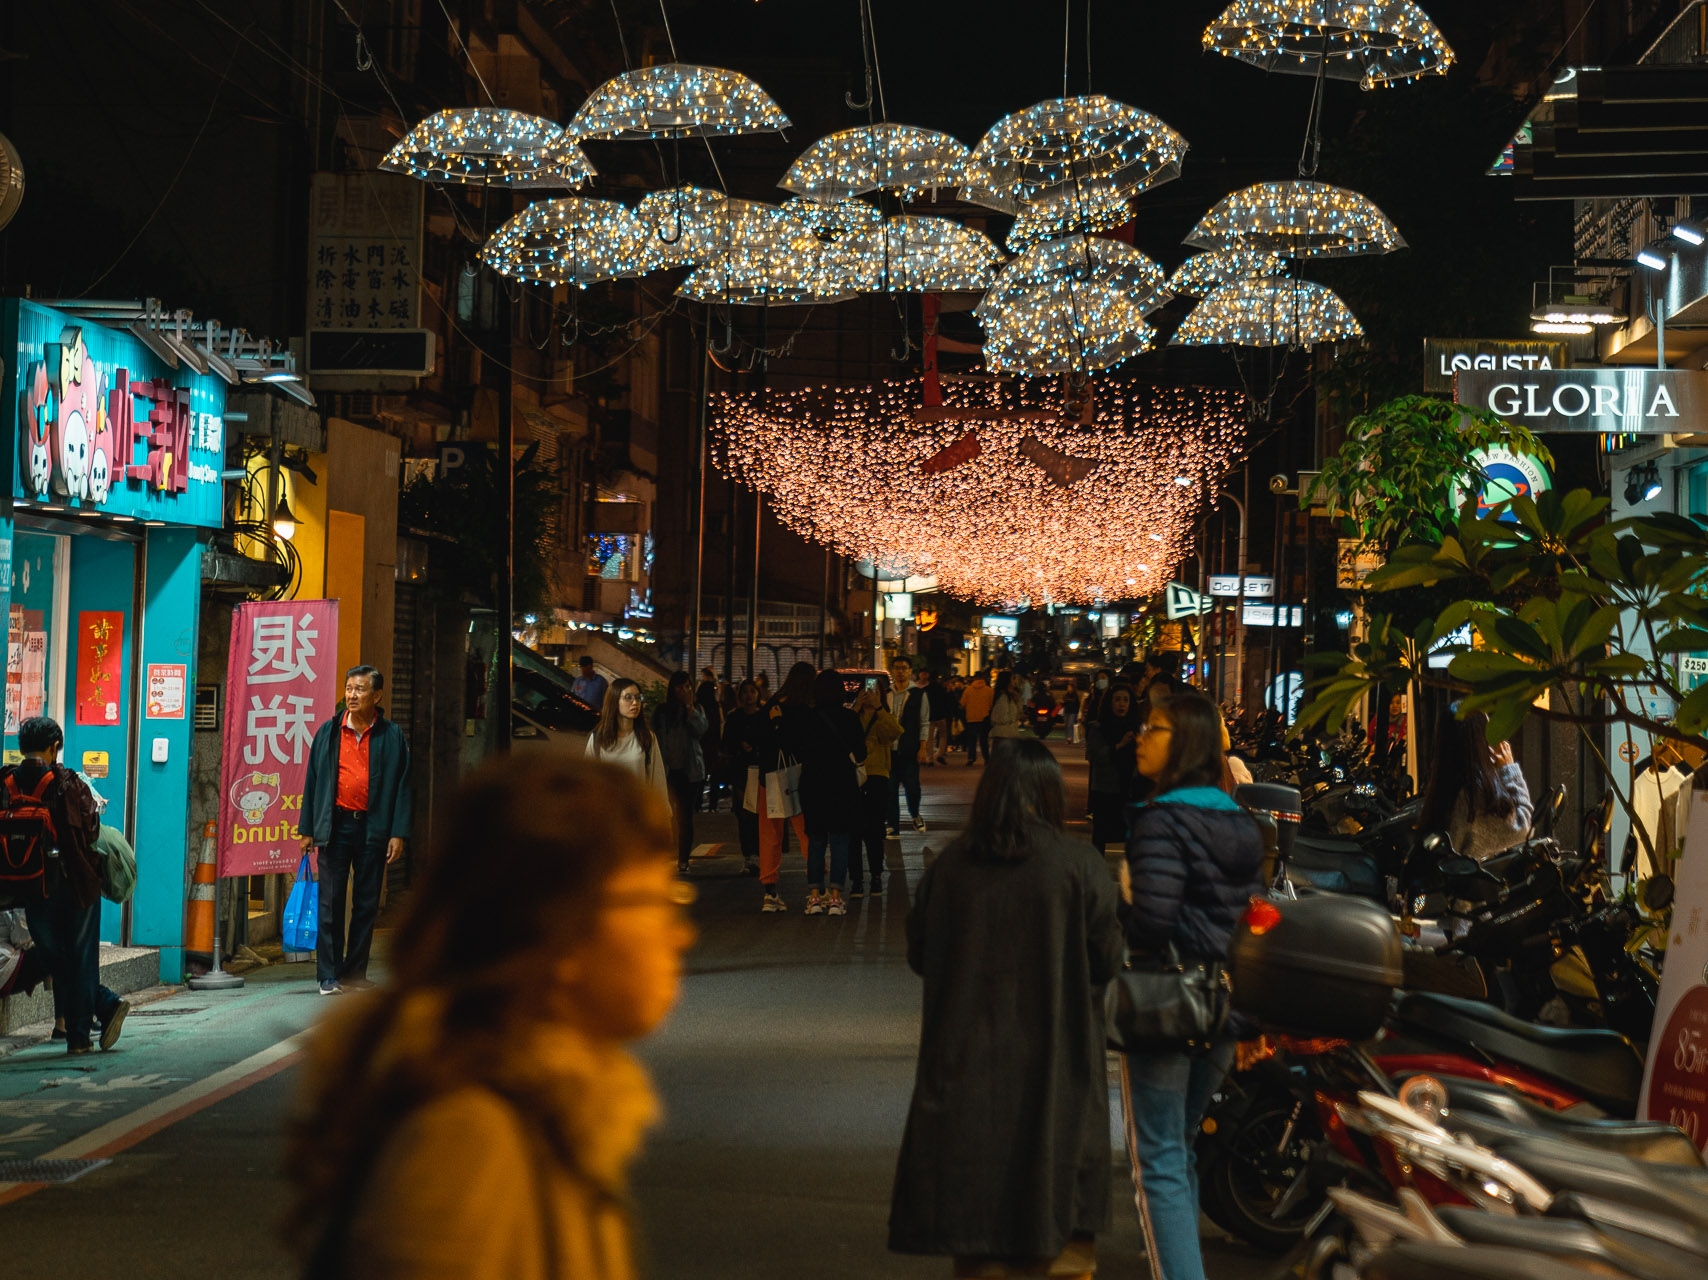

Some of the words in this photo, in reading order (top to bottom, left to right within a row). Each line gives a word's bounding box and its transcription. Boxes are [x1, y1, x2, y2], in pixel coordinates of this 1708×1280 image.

[1488, 382, 1680, 418] GLORIA
[440, 447, 465, 479] P
[1478, 453, 1499, 465] NEW
[1503, 453, 1539, 484] FASHION
[1684, 659, 1707, 671] $250
